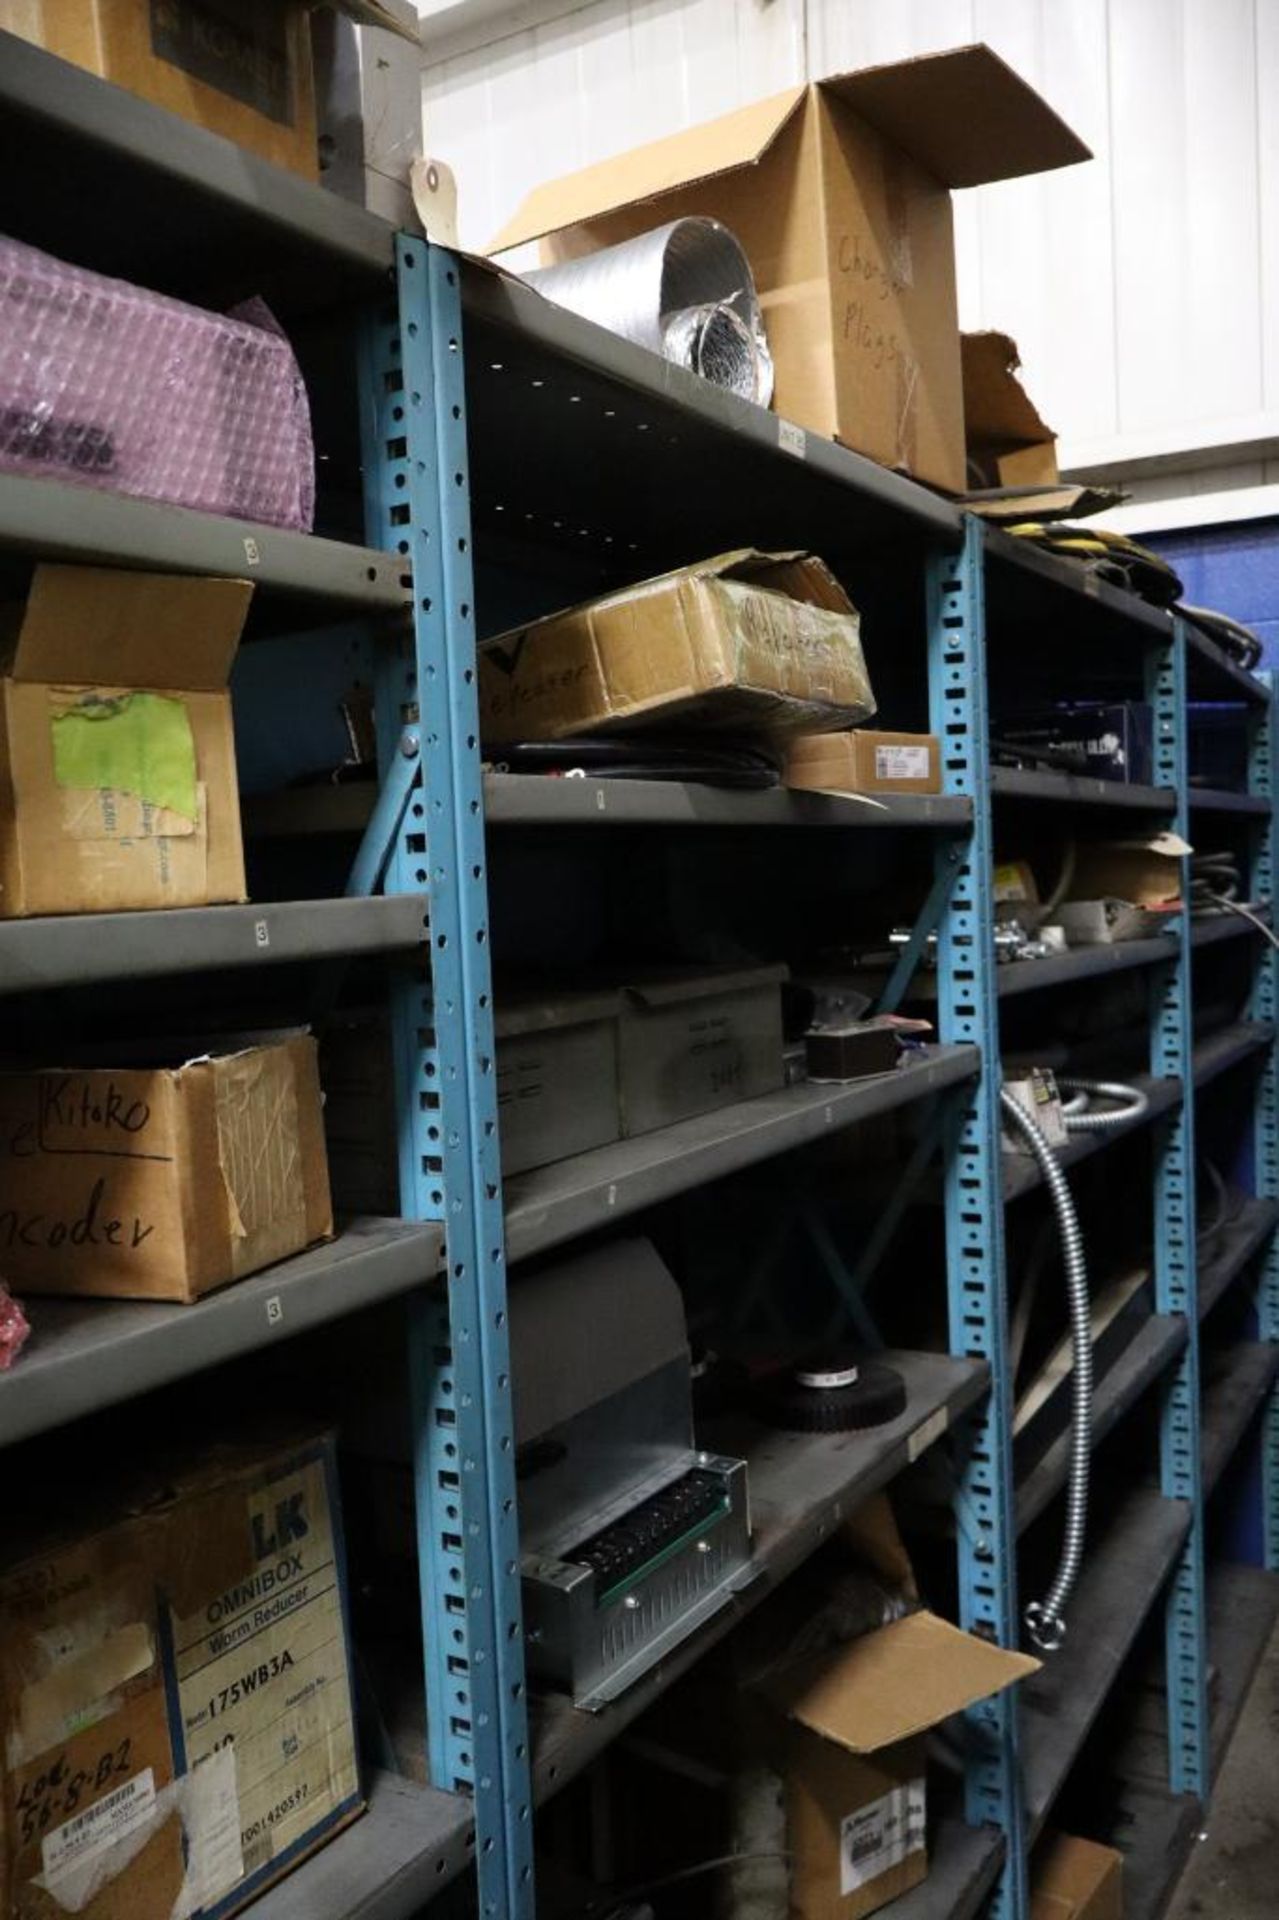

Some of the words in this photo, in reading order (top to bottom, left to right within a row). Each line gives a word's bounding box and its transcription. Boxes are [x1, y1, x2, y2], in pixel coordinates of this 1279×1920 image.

[257, 926, 267, 941] 3
[269, 1303, 279, 1318] 3
[206, 1554, 304, 1624] OMNIBOX
[208, 1620, 251, 1655] Worm
[253, 1584, 309, 1626] Reducer
[208, 1649, 295, 1719] 175WB3A
